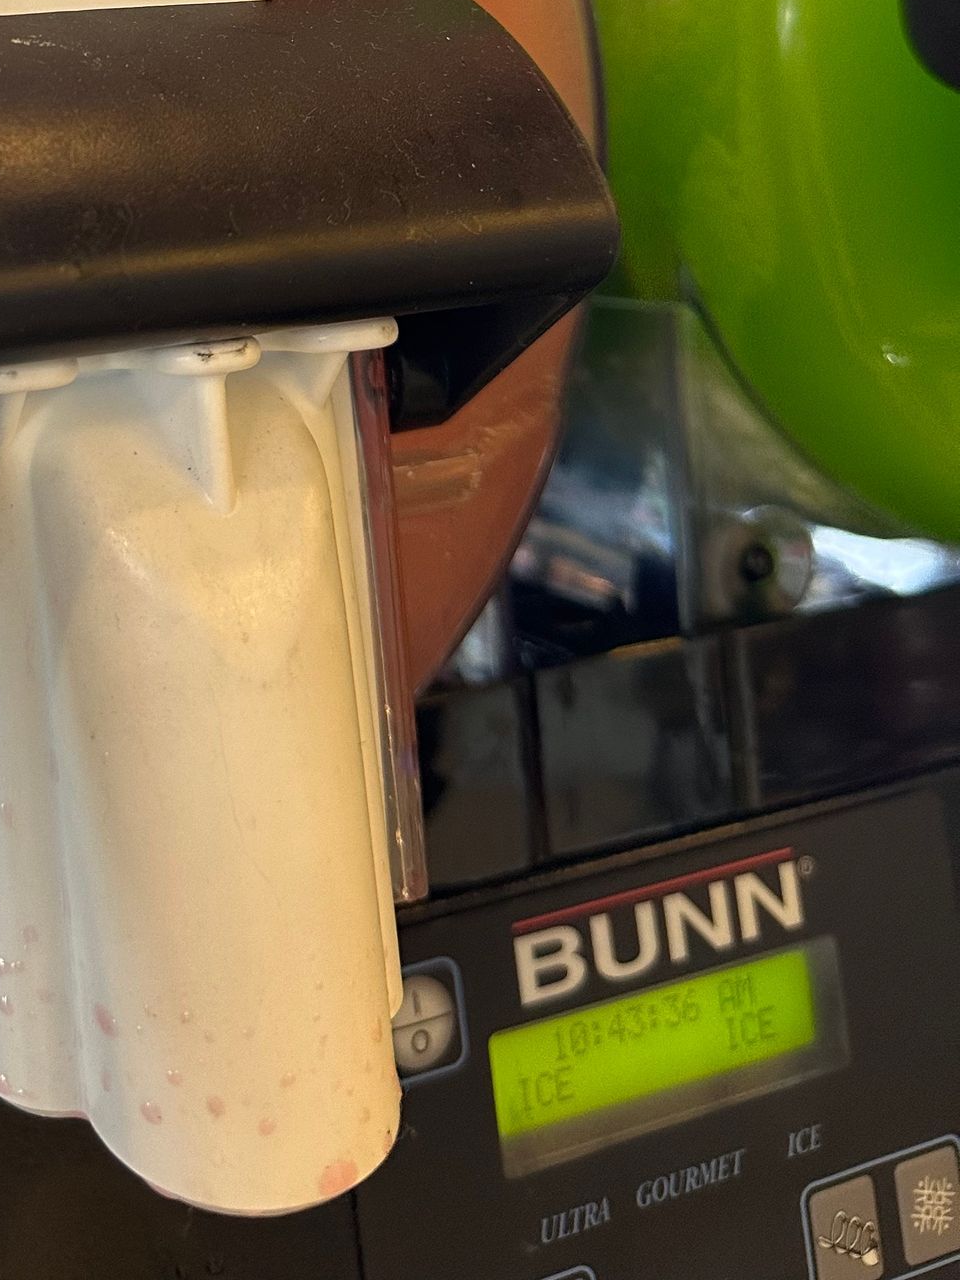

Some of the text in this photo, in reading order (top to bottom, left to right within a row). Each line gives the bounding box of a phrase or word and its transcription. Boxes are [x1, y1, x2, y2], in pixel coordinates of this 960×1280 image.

[516, 1005, 778, 1112] ICE ICE
[554, 973, 758, 1061] 10:43:36 AM
[541, 1124, 822, 1244] ULTRA GOURMET ICE
